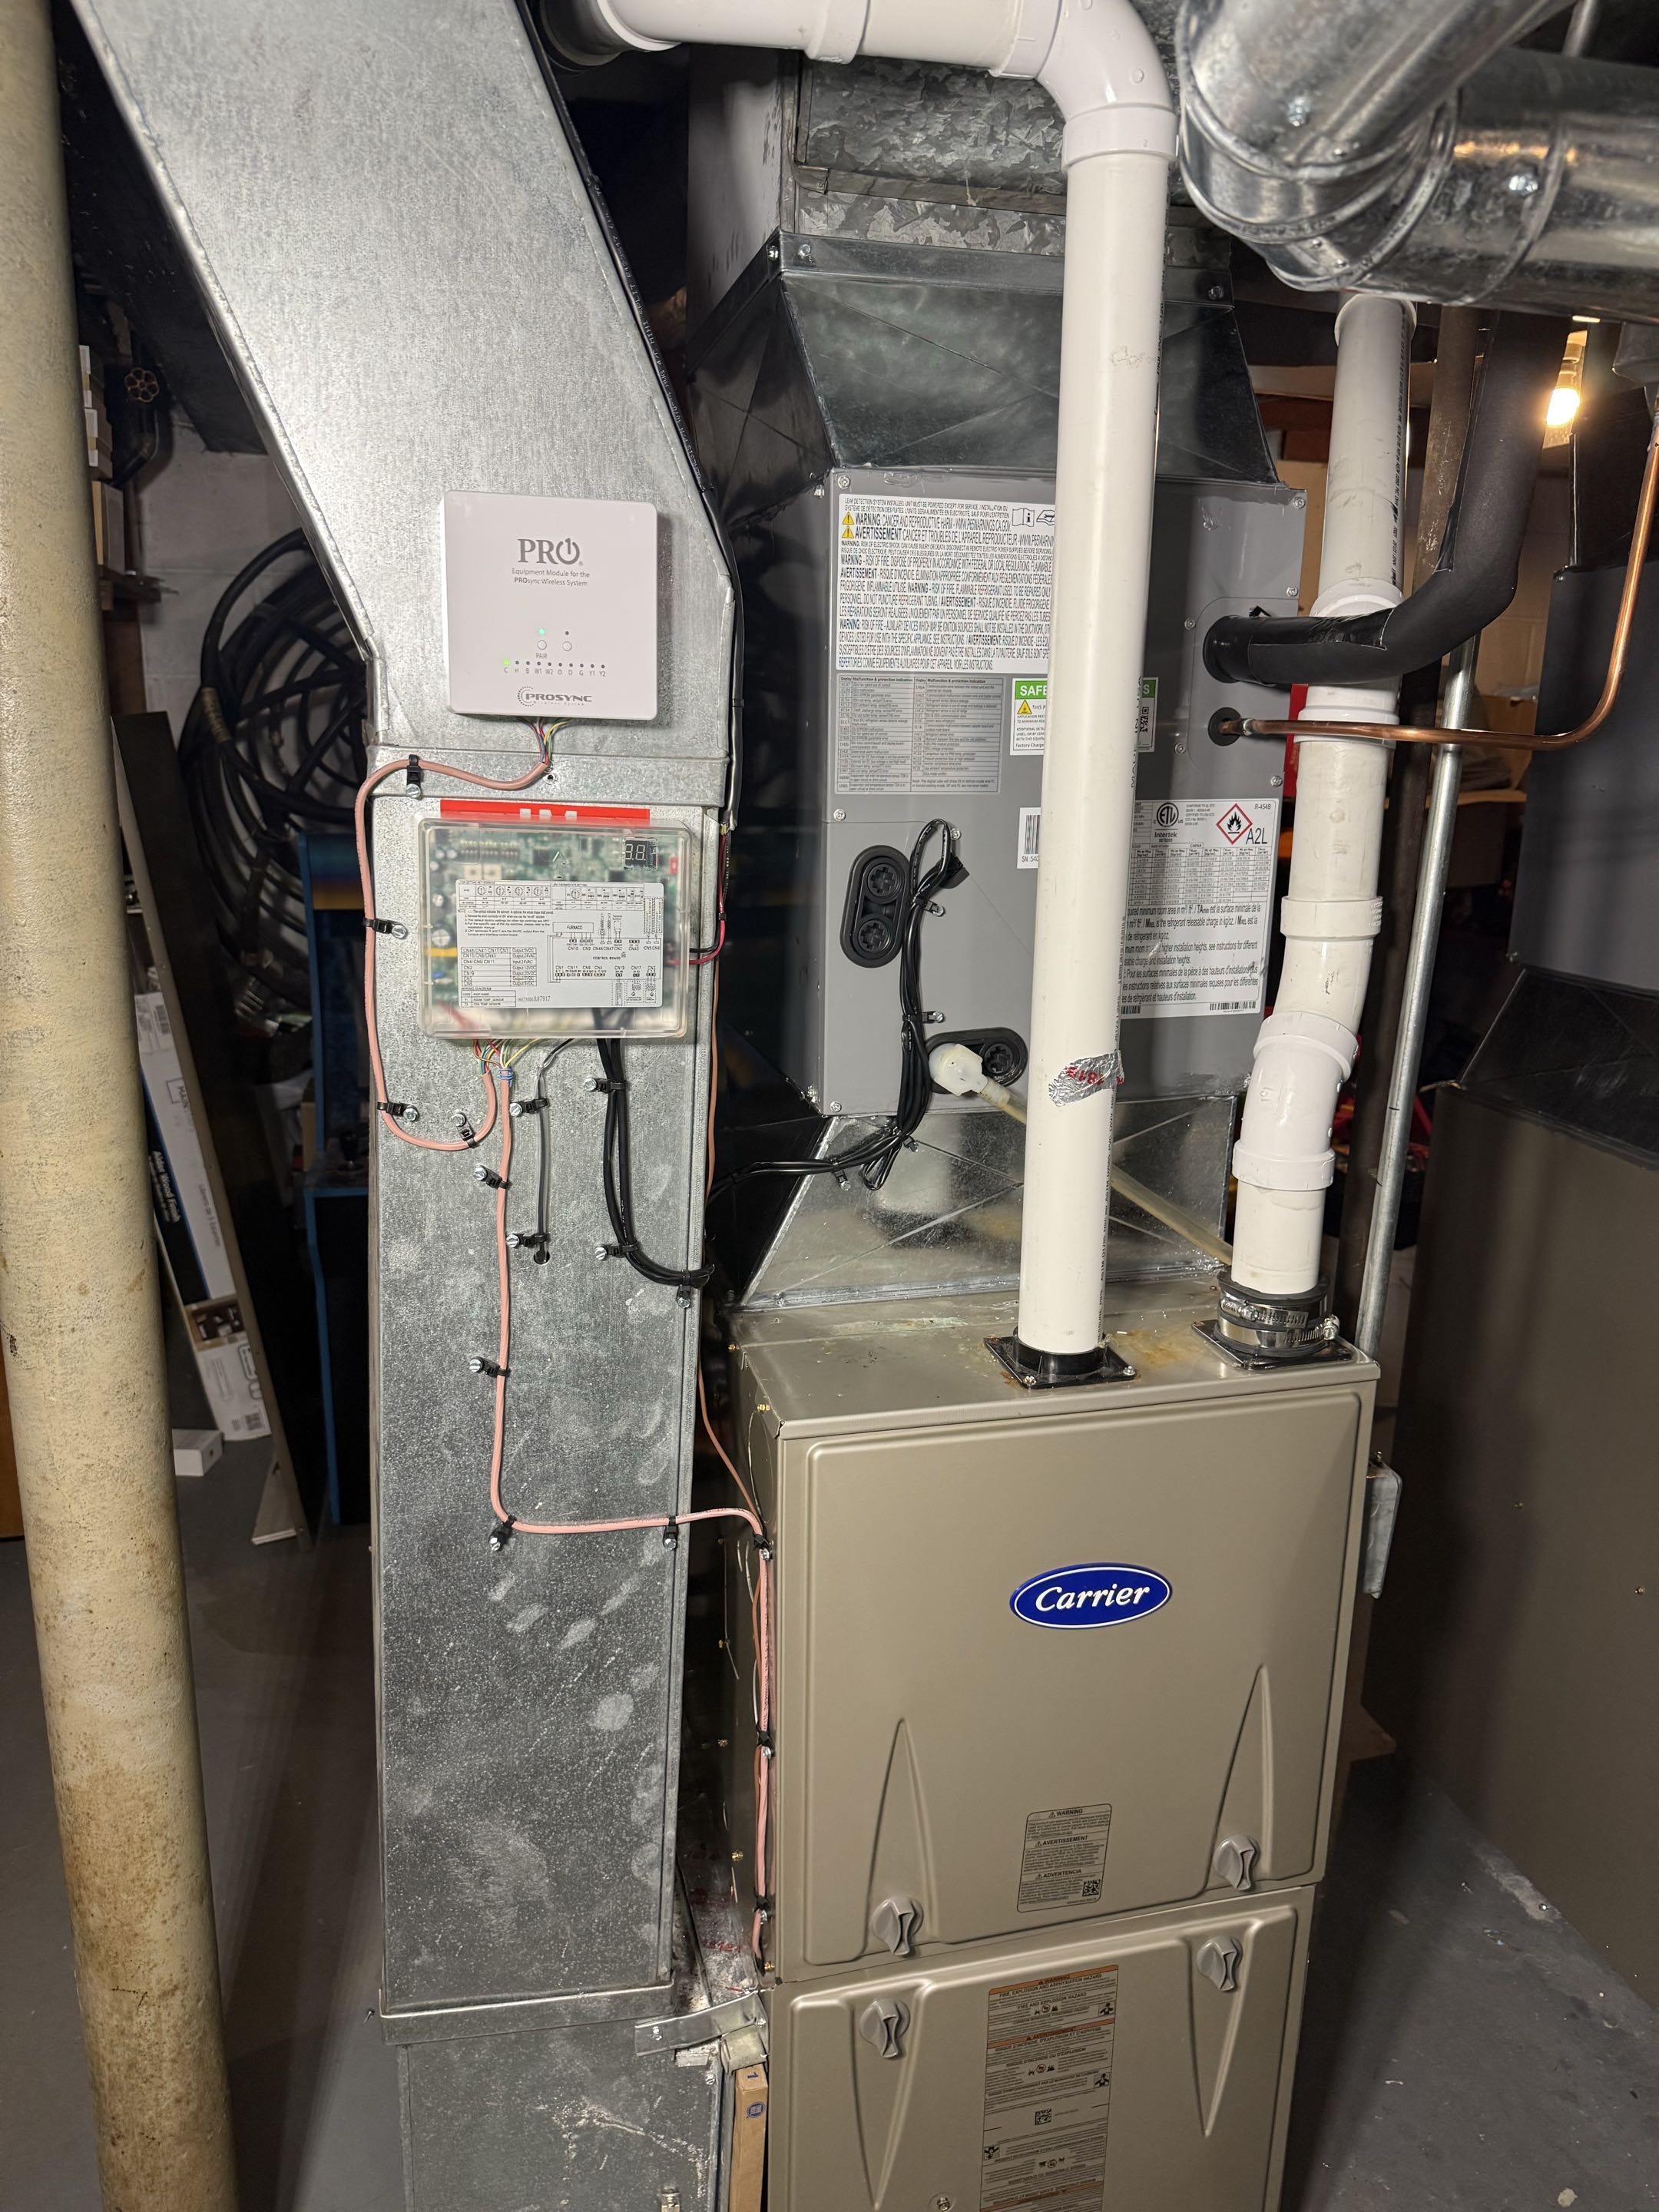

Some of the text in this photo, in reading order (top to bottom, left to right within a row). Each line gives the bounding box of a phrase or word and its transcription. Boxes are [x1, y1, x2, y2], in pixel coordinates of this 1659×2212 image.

[882, 514, 899, 526] CANCER
[899, 515, 908, 527] AND
[909, 515, 940, 528] REPRODUCTIVE
[941, 516, 952, 529] HARM
[902, 528, 920, 541] CANCER
[922, 529, 927, 541] ET
[928, 529, 950, 542] TROUBLES
[952, 531, 957, 542] DE
[982, 532, 1017, 545] REPRODUCTEUR
[840, 554, 862, 565] WARNING
[866, 555, 874, 565] RISK
[875, 555, 879, 565] OF
[890, 556, 906, 566] DISPOSE
[907, 557, 912, 567] OF
[913, 557, 932, 568] PROPERLY
[932, 558, 935, 568] IN
[936, 558, 961, 568] ACCORDANCE
[962, 559, 970, 569] WITH
[971, 559, 987, 570] FEDERAL
[988, 560, 993, 570] OR
[994, 561, 1005, 571] LOCAL
[1031, 562, 1051, 572] FLAMMABLE
[512, 567, 545, 576] Equipment
[840, 567, 893, 579] AVERTISSEMENT RISQUE
[514, 577, 540, 585] PROsync
[525, 691, 592, 704] PROSYNC
[1246, 827, 1268, 844] A2L
[159, 1174, 174, 1197] Wood
[164, 1199, 181, 1222] Finish
[1035, 1583, 1151, 1611] Carrier
[1042, 1835, 1088, 1845] AVERTISSEMENT
[1043, 1868, 1081, 1878] ADVERTENCIA
[1012, 1986, 1038, 1995] EXPLOSION
[1041, 1996, 1066, 2005] EXPLOSION
